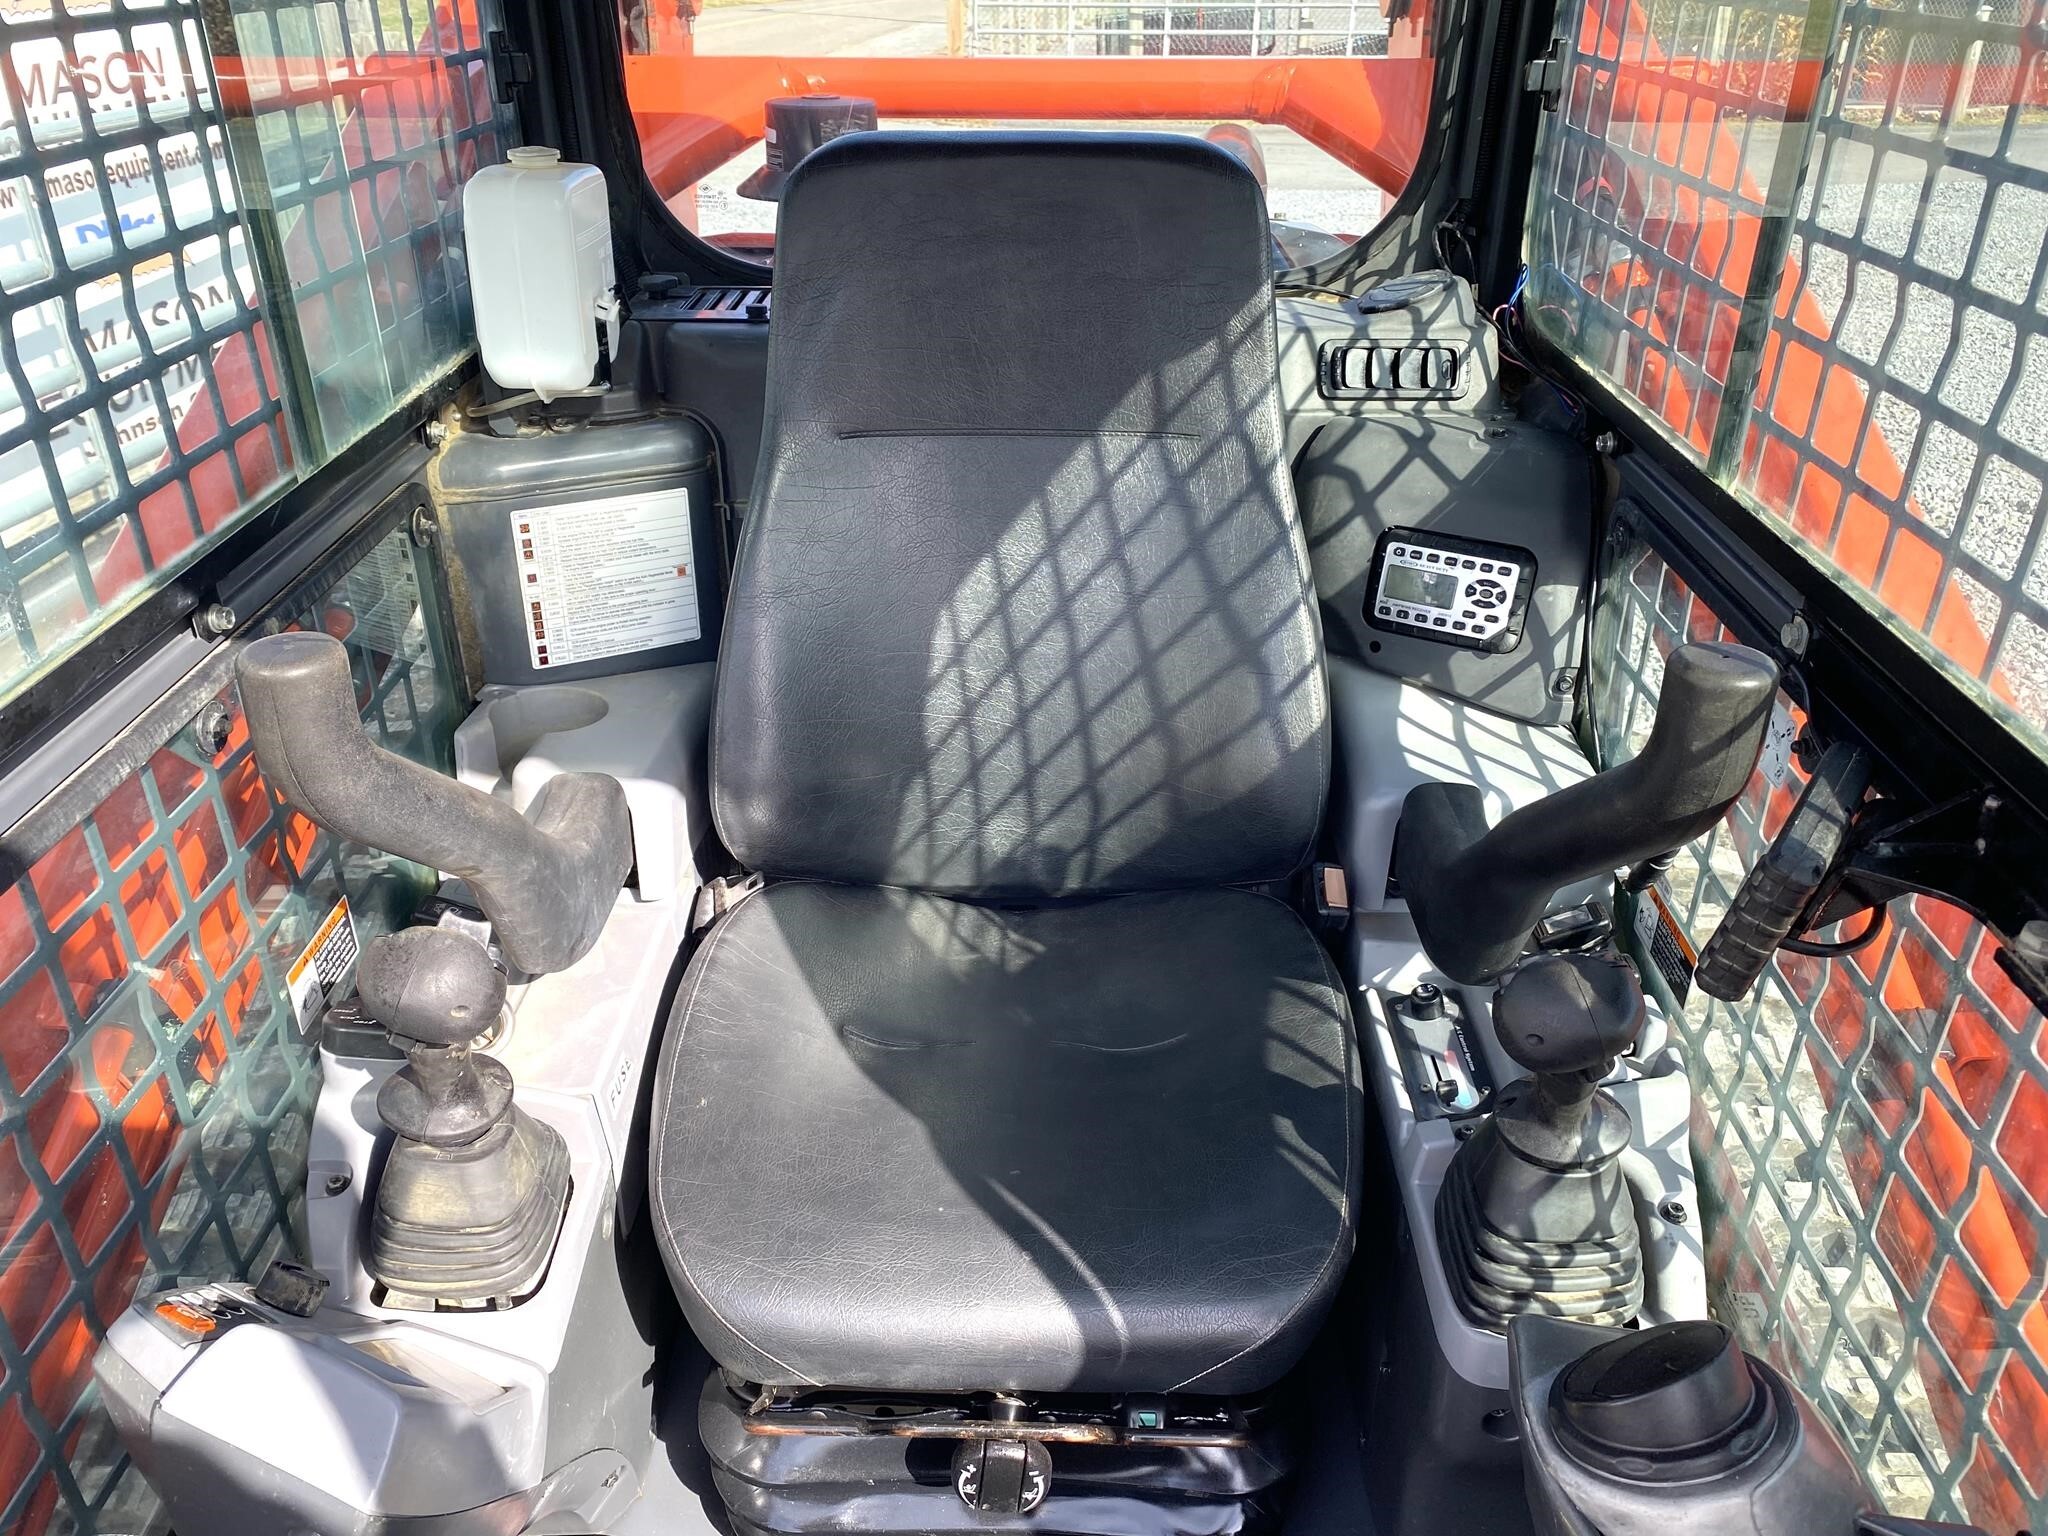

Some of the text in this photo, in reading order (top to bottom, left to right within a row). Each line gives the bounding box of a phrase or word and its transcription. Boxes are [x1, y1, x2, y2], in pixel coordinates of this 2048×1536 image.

[15, 47, 167, 108] MASON
[308, 916, 336, 958] WARNING
[1458, 1034, 1469, 1052] Control
[610, 1056, 633, 1110] FUSE
